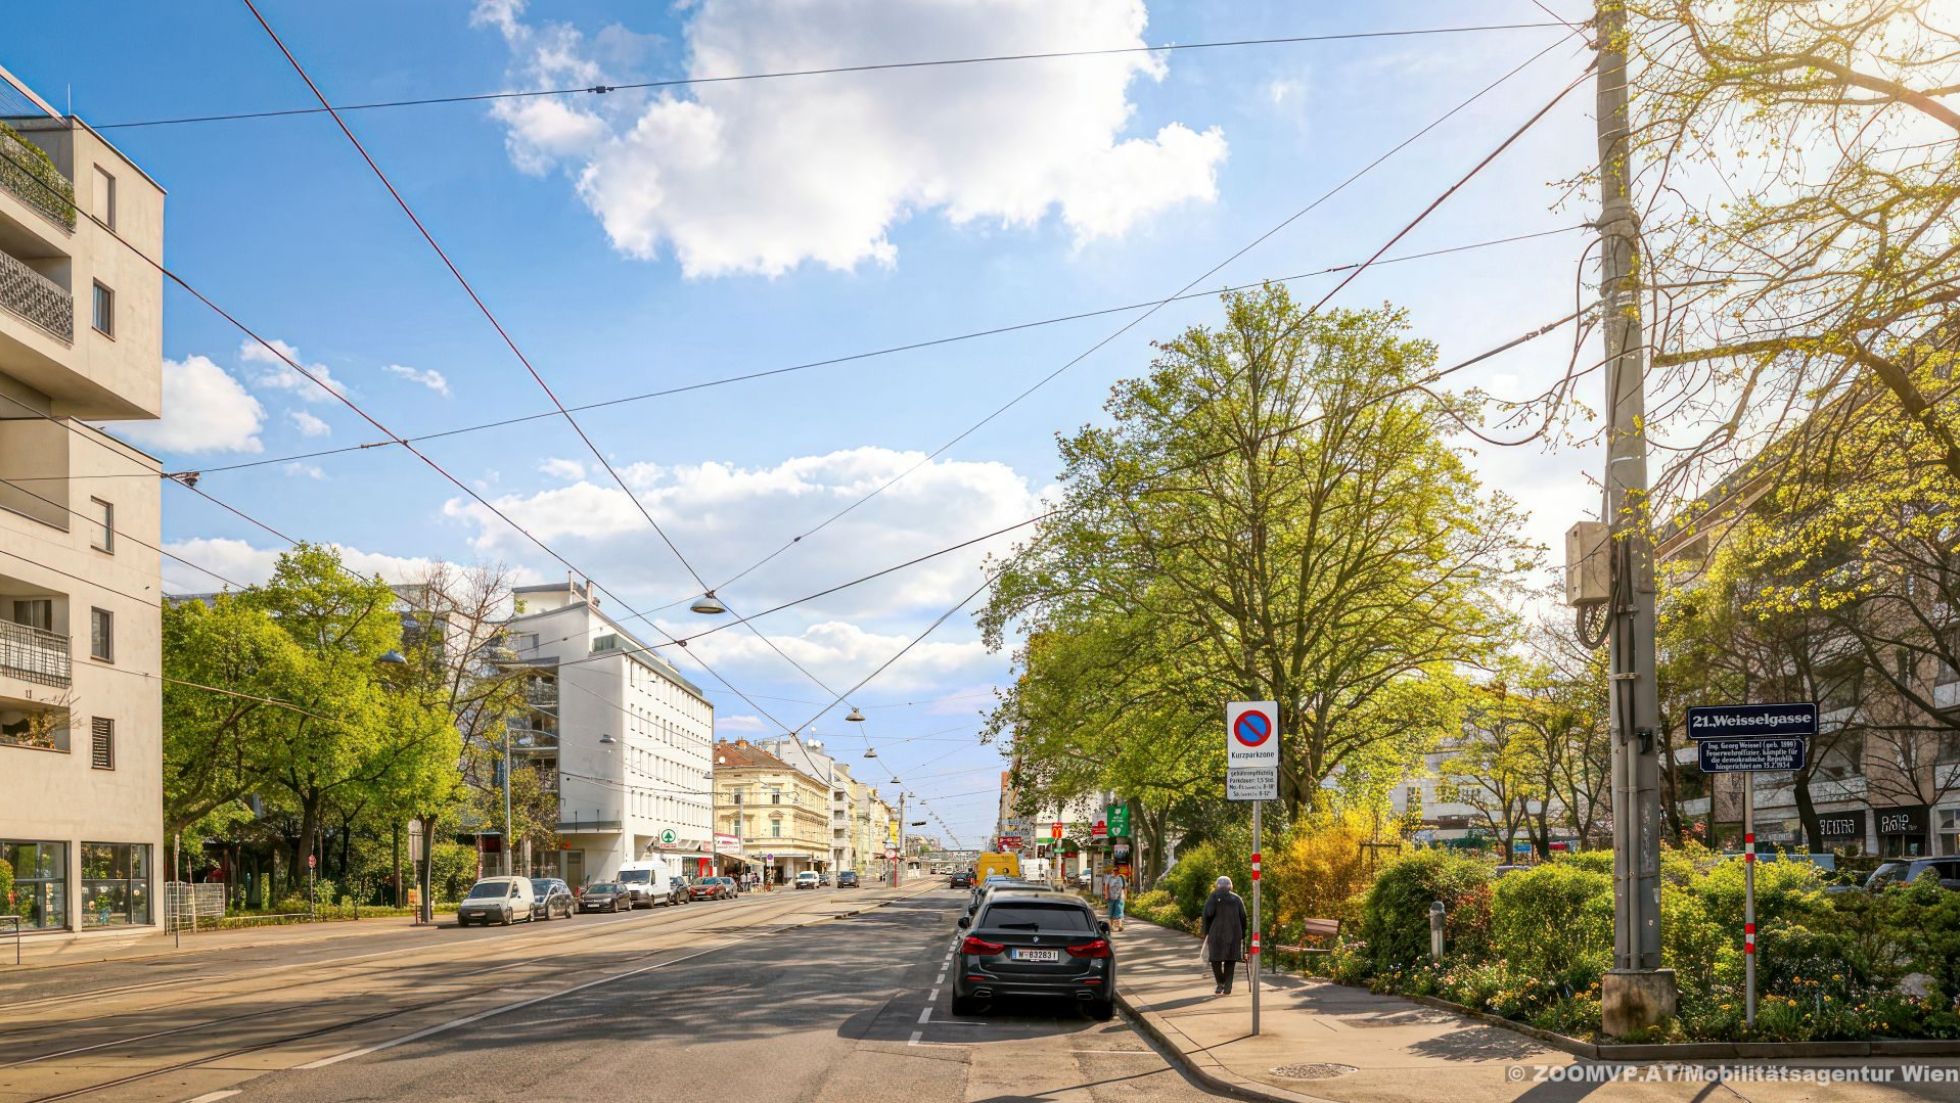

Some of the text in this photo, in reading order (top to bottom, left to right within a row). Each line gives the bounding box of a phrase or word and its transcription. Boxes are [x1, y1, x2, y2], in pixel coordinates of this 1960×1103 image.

[1714, 713, 1812, 728] Weisselgasse
[1707, 742, 1719, 750] Ing.
[1721, 742, 1739, 750] Georg
[1739, 741, 1762, 749] Weissel
[1721, 756, 1766, 764] demokratische
[1766, 755, 1794, 763] Republik
[1715, 763, 1752, 771] hingerichtet
